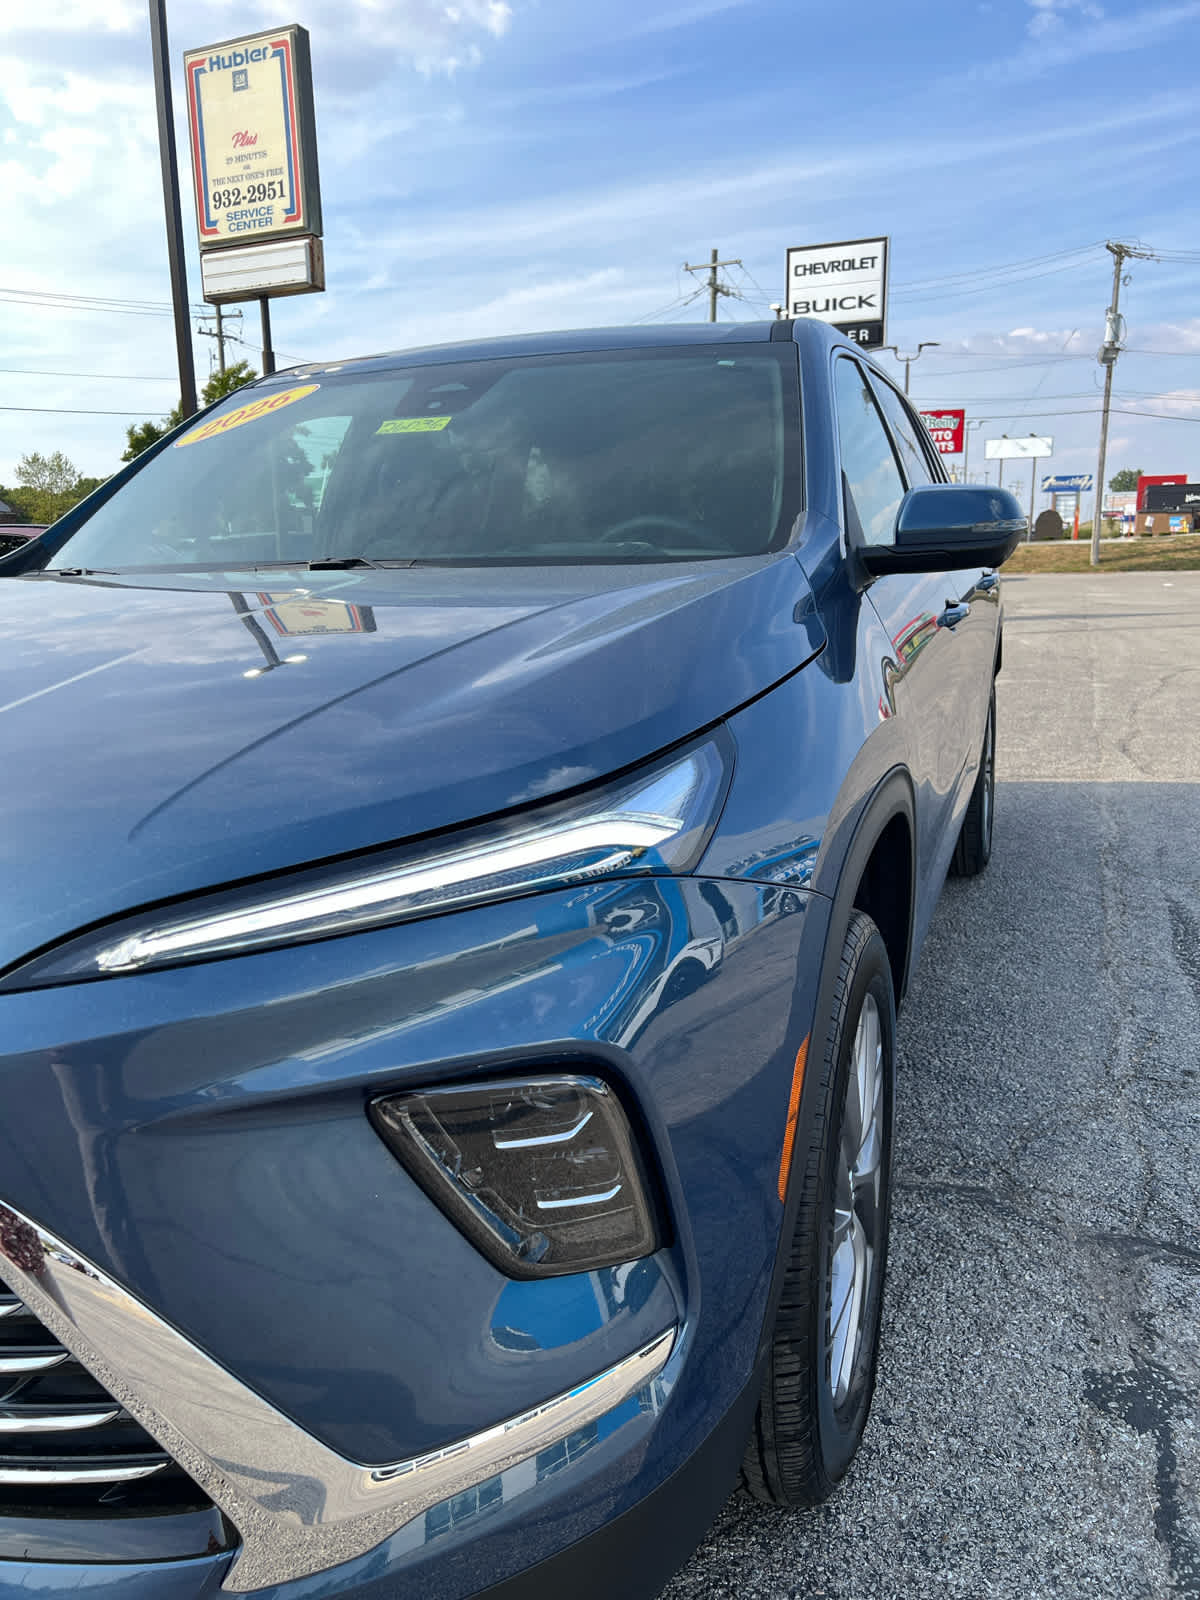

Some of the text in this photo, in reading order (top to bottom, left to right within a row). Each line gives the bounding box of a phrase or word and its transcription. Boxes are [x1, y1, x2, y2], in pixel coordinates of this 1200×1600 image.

[209, 47, 269, 72] Hubler
[232, 130, 258, 149] Plus
[212, 179, 286, 210] 932-2951
[226, 205, 274, 222] SERVICE
[228, 216, 273, 233] CENTER
[794, 256, 879, 277] CHEVROLET
[793, 294, 877, 315] BUICK
[847, 329, 869, 341] ER
[194, 389, 298, 441] 2026
[930, 430, 953, 441] UTO
